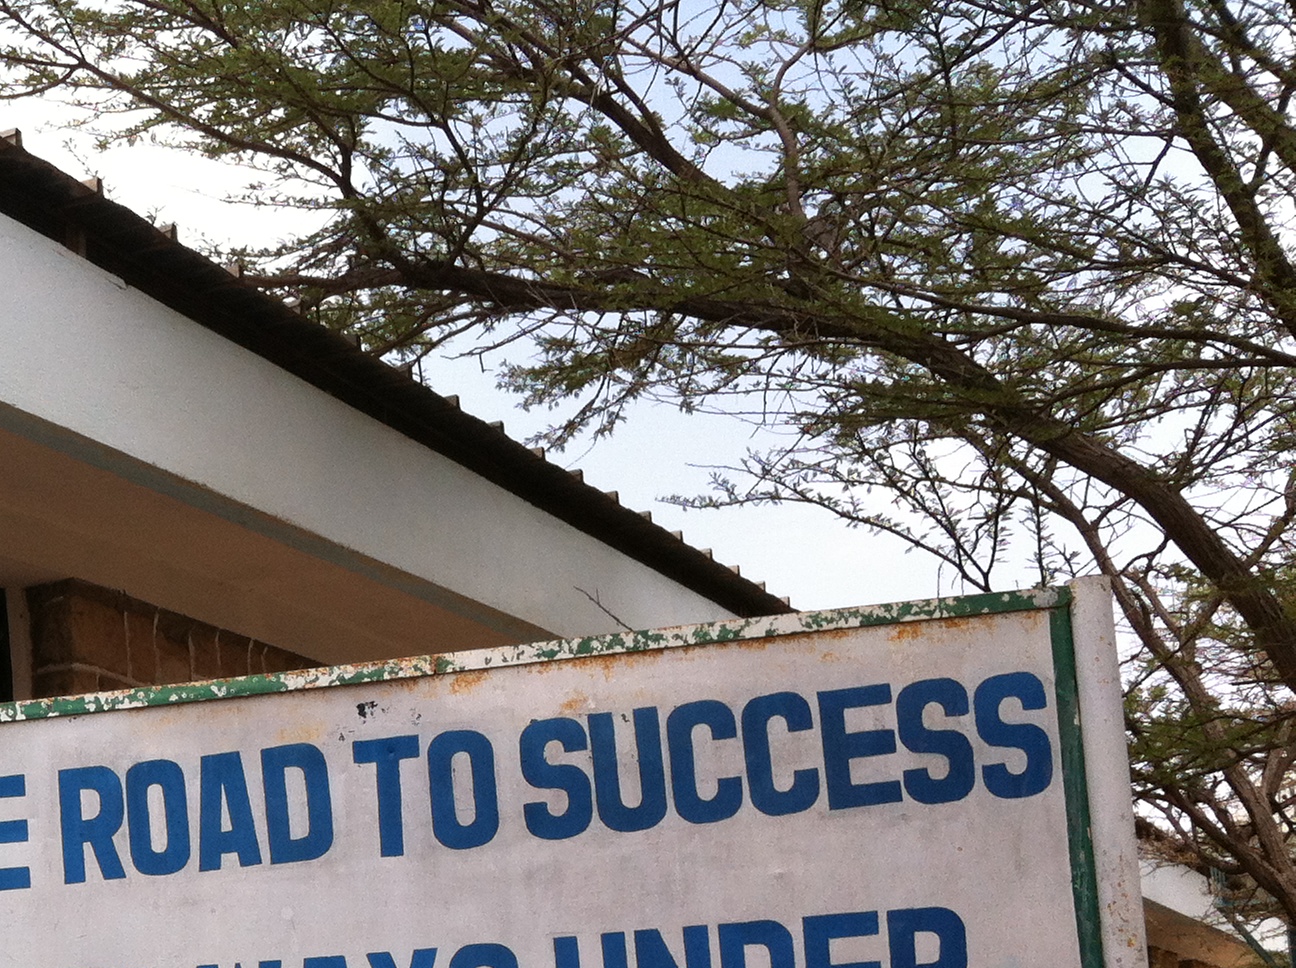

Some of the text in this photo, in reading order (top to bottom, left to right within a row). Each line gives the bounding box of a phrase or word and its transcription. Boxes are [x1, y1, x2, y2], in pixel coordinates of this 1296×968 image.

[59, 743, 334, 885] ROAD
[353, 729, 499, 858] TO
[522, 671, 1053, 841] SUCCESS
